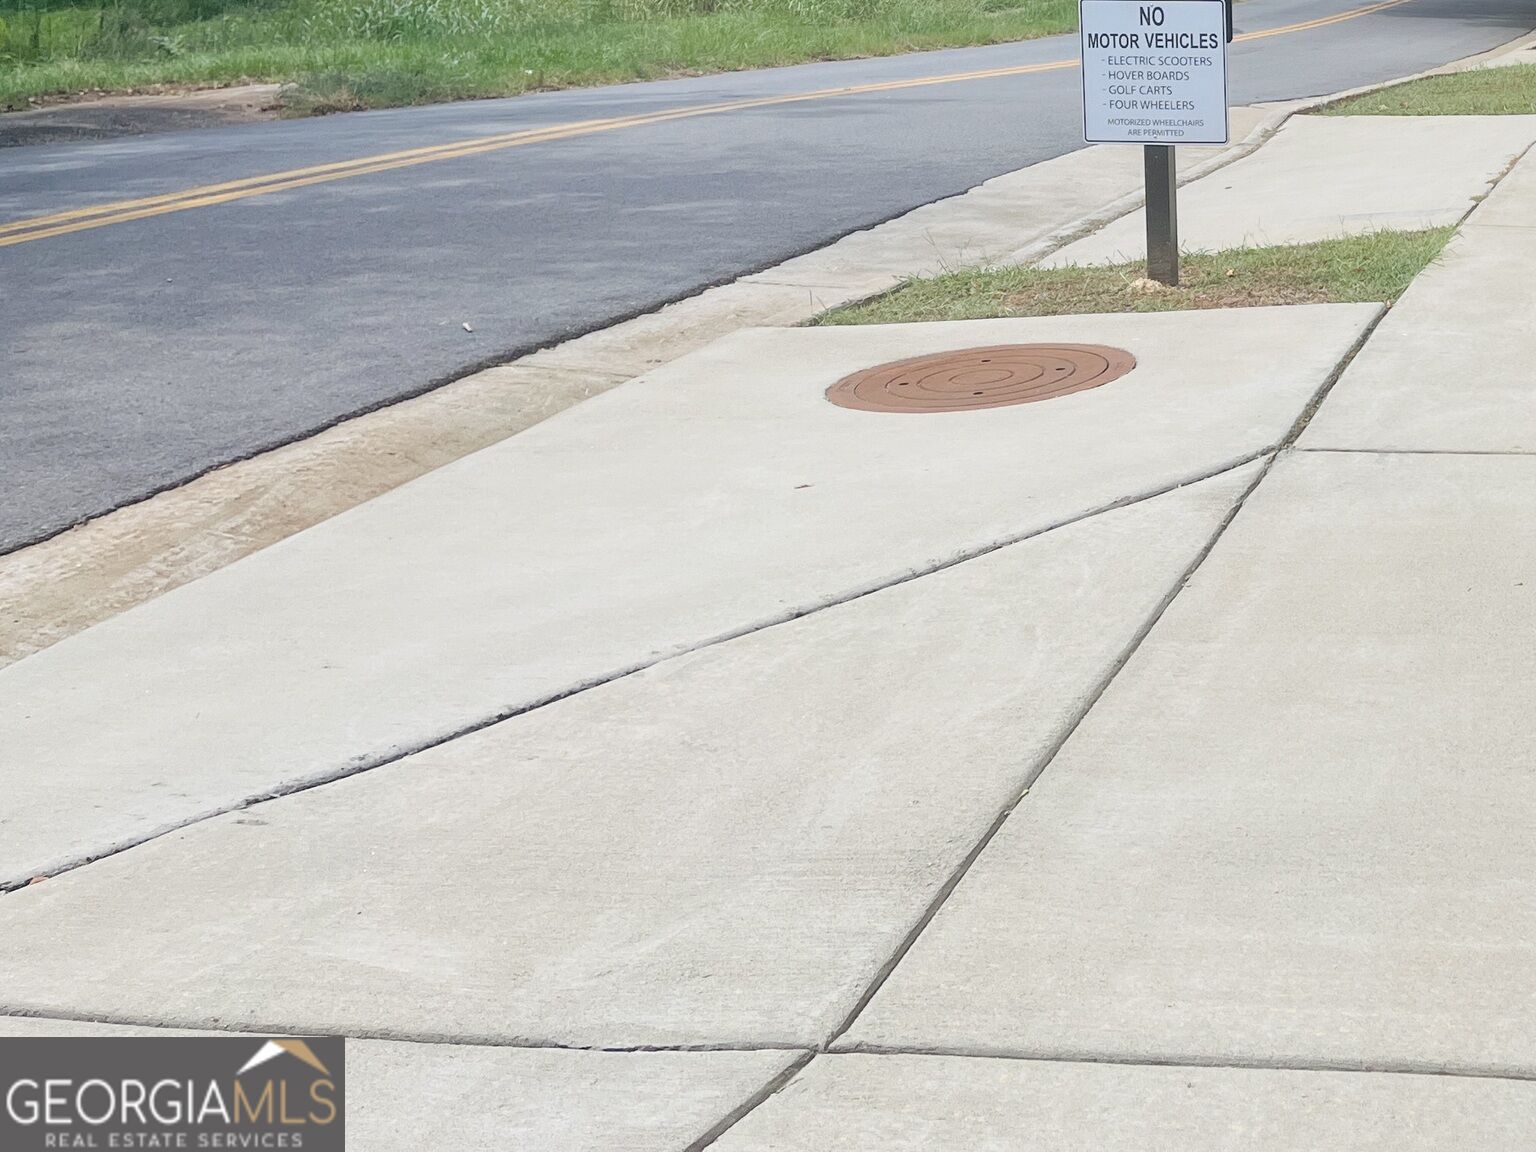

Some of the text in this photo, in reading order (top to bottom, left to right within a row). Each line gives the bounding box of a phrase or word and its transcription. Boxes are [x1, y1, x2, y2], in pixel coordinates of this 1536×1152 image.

[1139, 6, 1165, 26] NO
[1088, 33, 1219, 49] MOTOR VEHICLES
[1107, 55, 1213, 66] ELECTRIC SCOOTERS
[1108, 70, 1190, 81] HOVER BOARDS
[1108, 85, 1173, 96] GOLF CARTS
[1109, 99, 1195, 110] FOUR WHEELERS
[1107, 118, 1205, 127] MOTORIZED WHEELCHAIRS
[1143, 129, 1185, 137] PERMITTED
